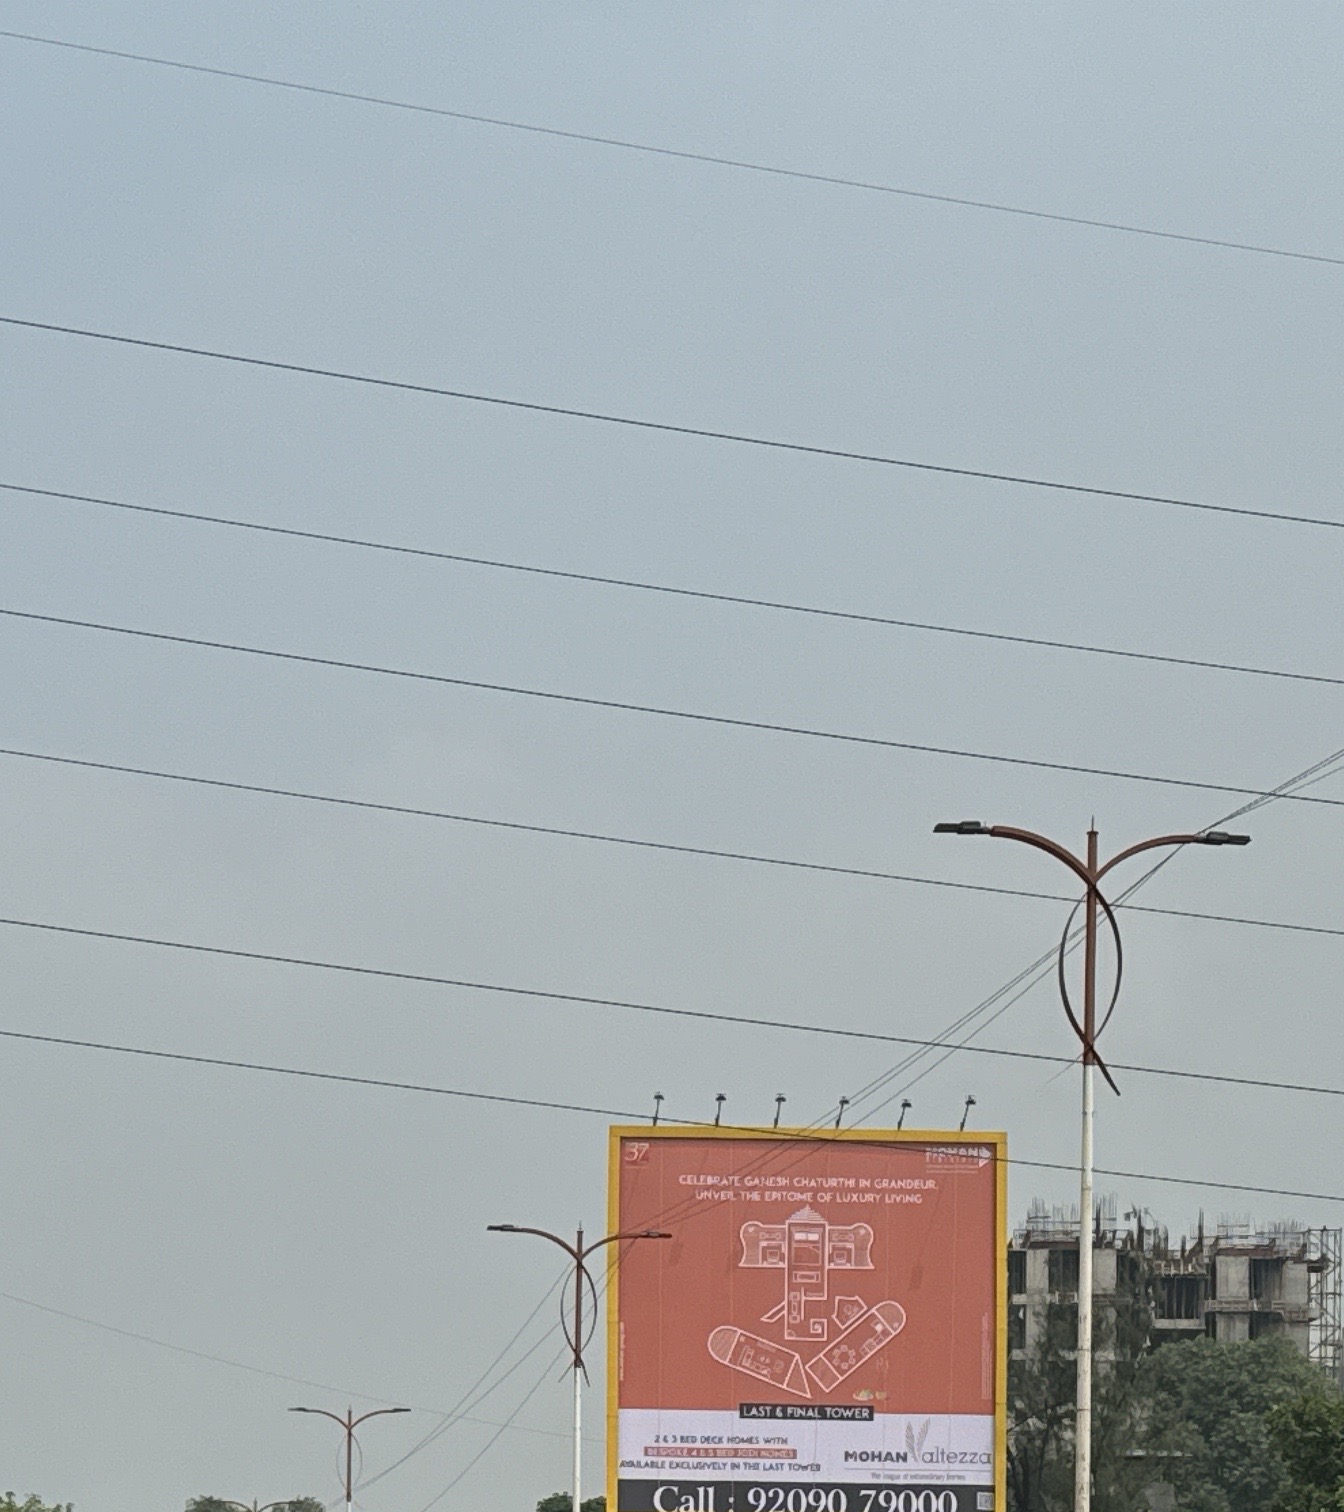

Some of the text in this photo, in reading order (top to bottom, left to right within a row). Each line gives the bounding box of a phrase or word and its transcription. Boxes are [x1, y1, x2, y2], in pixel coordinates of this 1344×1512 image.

[679, 1174, 741, 1187] CELEBRATE
[744, 1175, 790, 1187] GANESH
[793, 1176, 857, 1189] CHATURTHI
[859, 1178, 871, 1189] IN
[696, 1189, 923, 1204] UNVEIL THE EPITOME OF LUXURY LIVING
[743, 1406, 870, 1419] LAST & FINAL TOWER
[700, 1436, 724, 1444] DECK
[727, 1436, 760, 1445] HOMES
[844, 1446, 992, 1465] MOHAN altezza
[619, 1460, 665, 1469] AVAILABLE
[668, 1460, 727, 1471] EXCLUSIVELY
[762, 1462, 785, 1471] LAST
